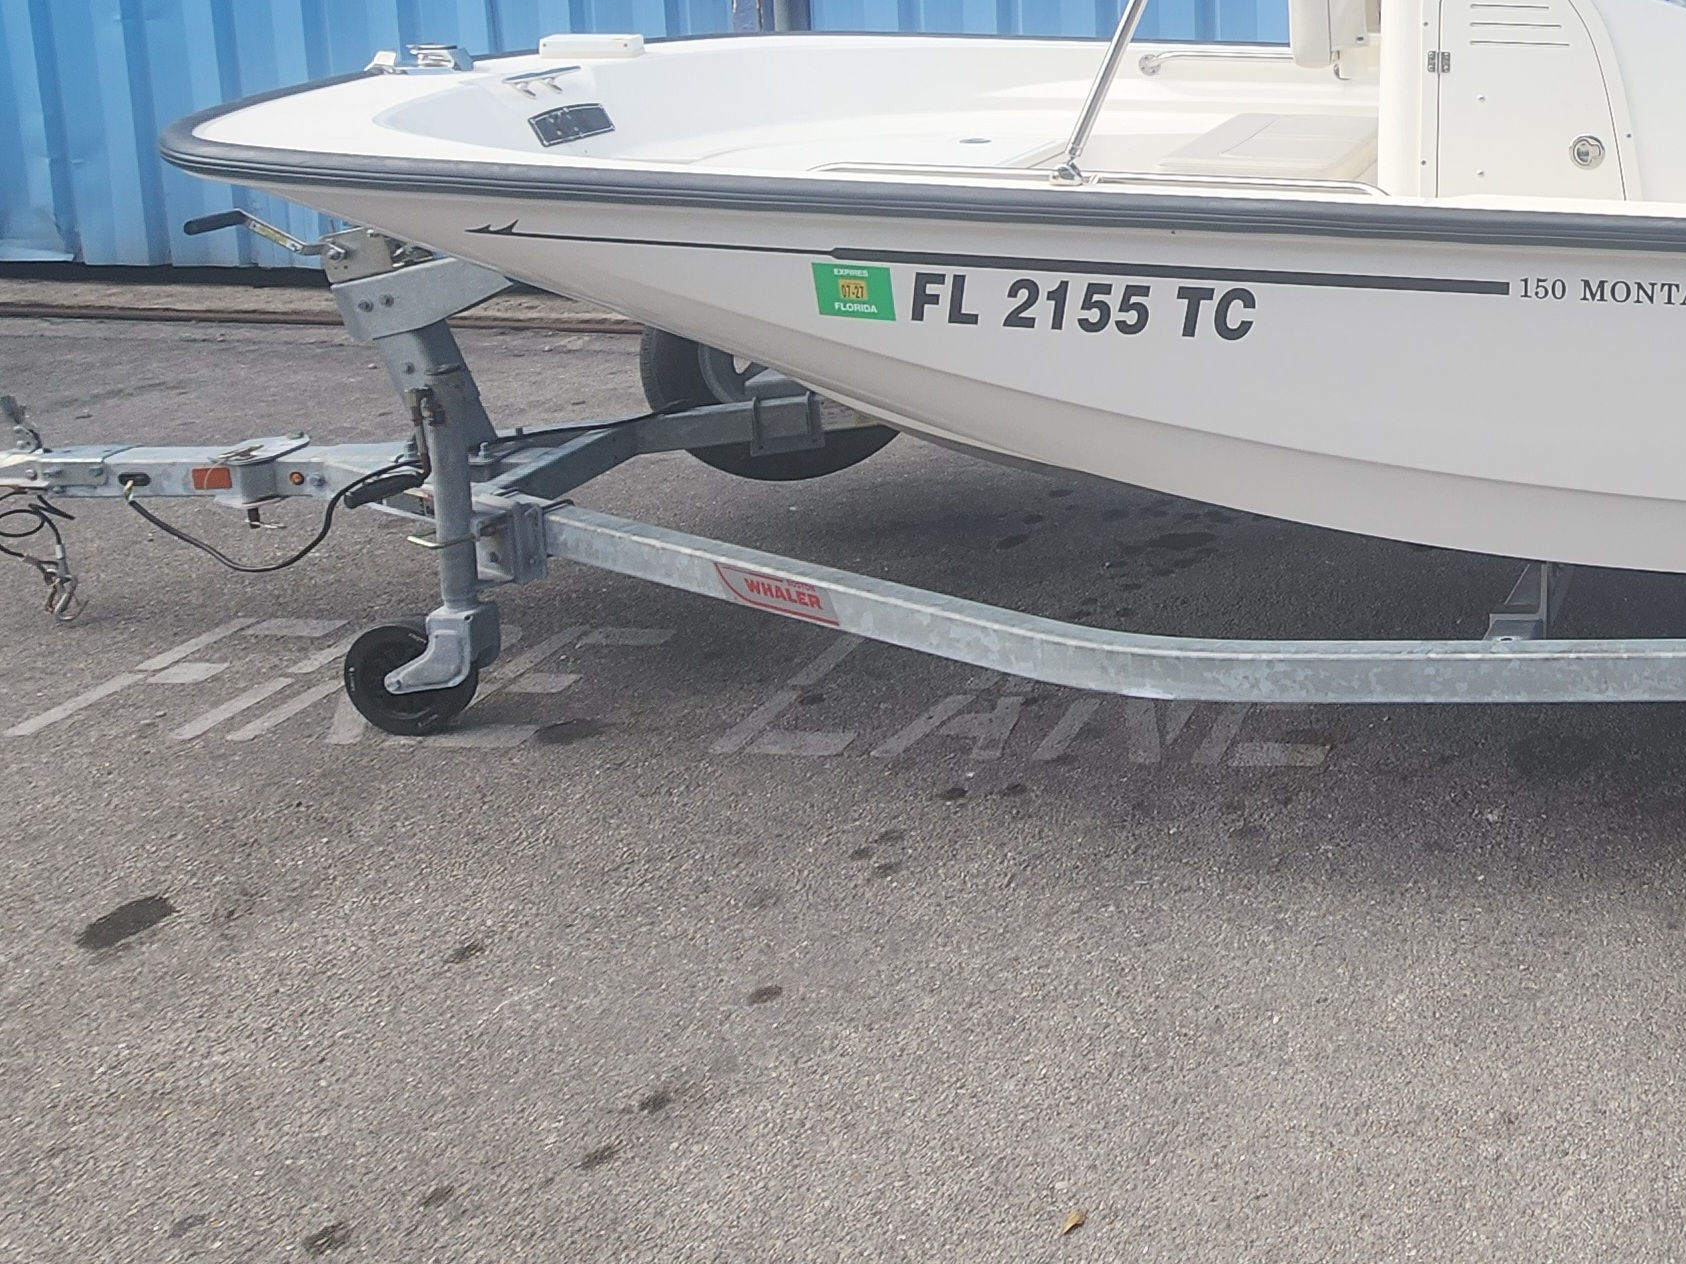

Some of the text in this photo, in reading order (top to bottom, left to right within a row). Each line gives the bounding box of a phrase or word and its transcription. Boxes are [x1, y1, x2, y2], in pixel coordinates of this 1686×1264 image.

[1519, 277, 1567, 300] 150
[834, 301, 878, 314] FLORIDA
[910, 271, 1257, 342] FL 2155 TC
[744, 578, 823, 610] WHALER
